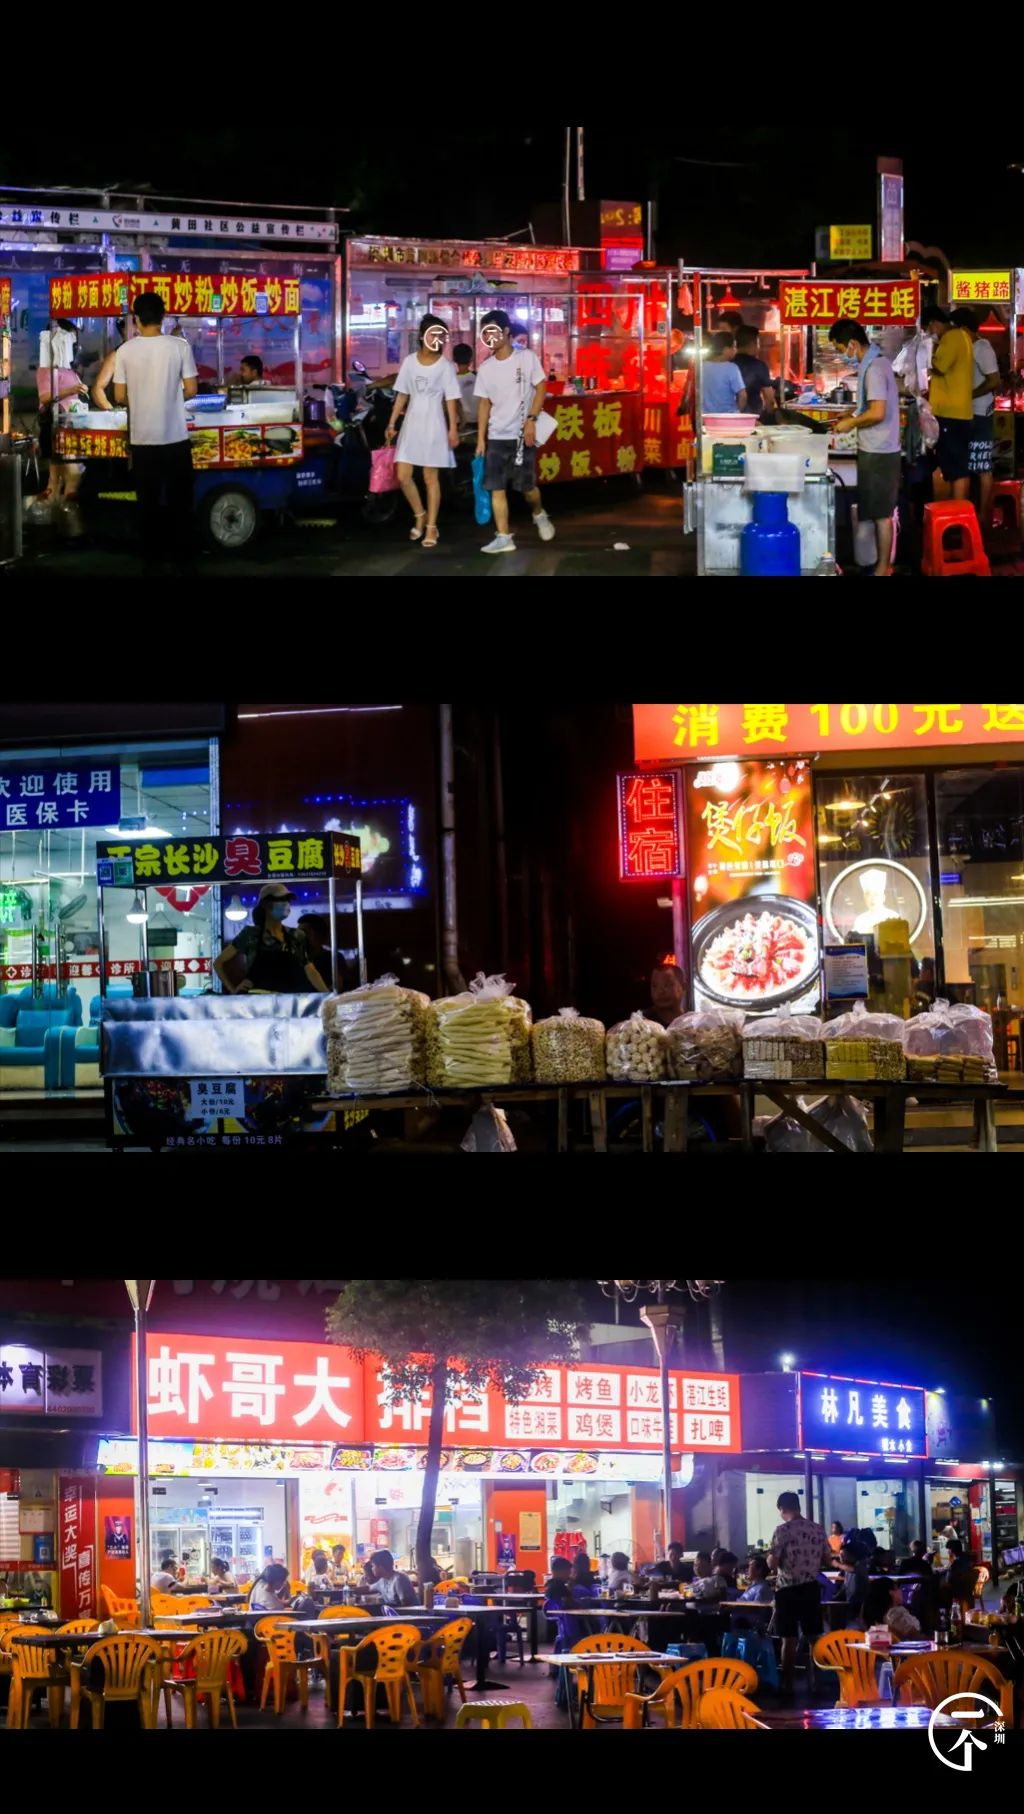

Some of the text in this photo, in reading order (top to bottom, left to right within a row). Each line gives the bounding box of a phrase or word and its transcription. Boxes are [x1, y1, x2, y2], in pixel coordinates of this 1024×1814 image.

[0, 208, 80, 225] 益宣传栏
[170, 217, 305, 238] 黄田社区公益宣传栏
[51, 281, 72, 310] 炒粉
[78, 280, 99, 308] 炒面
[130, 274, 300, 314] 江西炒粉炒饭炒面
[784, 287, 916, 319] 湛江烤生蚝
[956, 281, 1010, 299] 酱猪蹄
[554, 401, 623, 441] 铁板
[6, 799, 90, 826] 医保卡
[627, 778, 674, 873] 住宿
[701, 800, 807, 856] 煲仔饭
[197, 1083, 237, 1095] 臭豆腐
[166, 1136, 217, 1146] 经典名小吃
[575, 1375, 614, 1400] 烤鱼
[820, 1386, 912, 1431] 林凡美食
[509, 1410, 557, 1434] 特色湘菜
[575, 1412, 613, 1438] 鸡煲
[690, 1418, 725, 1442] 扎啤
[64, 1484, 78, 1563] 幸运大奖
